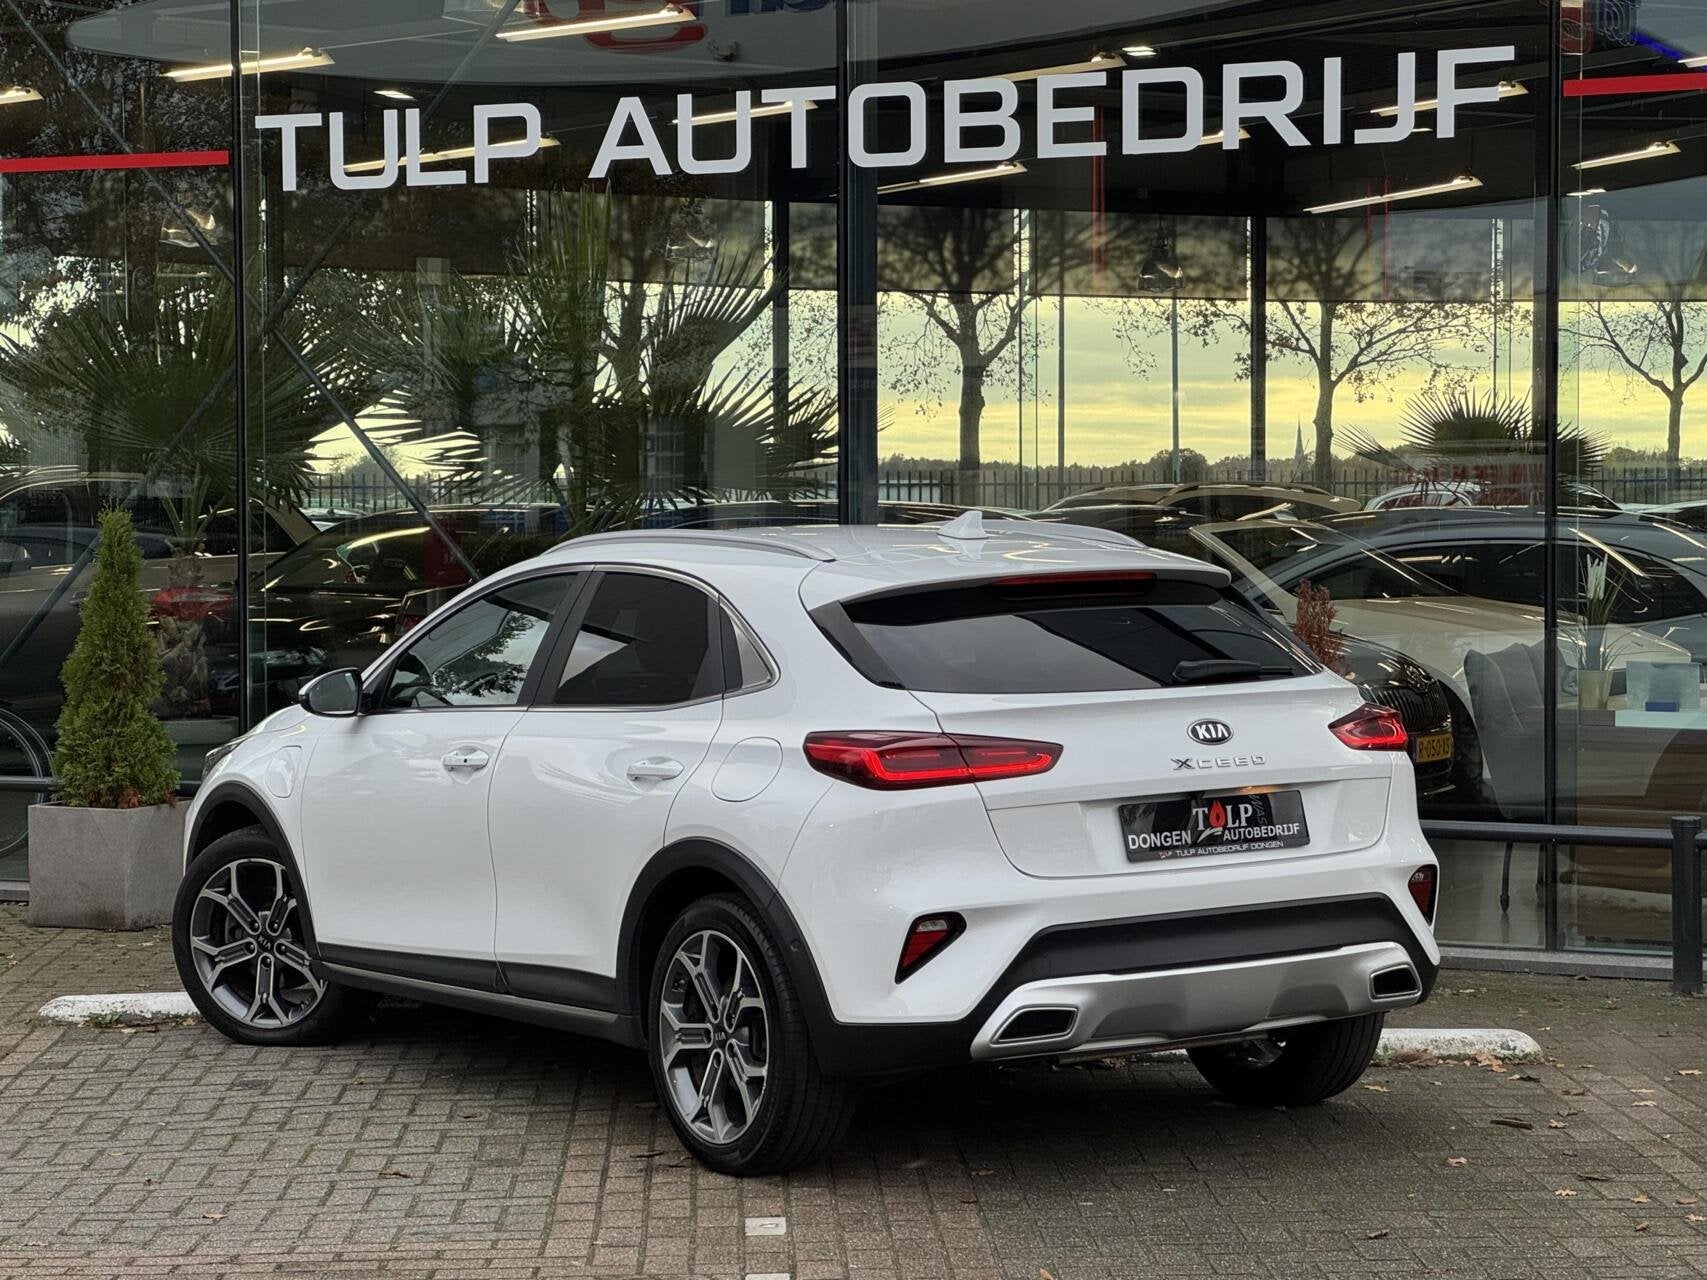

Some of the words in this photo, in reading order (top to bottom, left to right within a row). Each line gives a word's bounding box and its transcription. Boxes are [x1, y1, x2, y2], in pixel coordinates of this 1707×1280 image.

[255, 102, 541, 192] TULP
[589, 45, 1515, 180] AUTOBEDRIJF
[1194, 723, 1229, 740] KIA
[1170, 754, 1266, 771] XCEED
[1128, 830, 1191, 850] DONGEN
[1223, 822, 1300, 842] AUTOBEDRIJF
[1176, 847, 1196, 857] TULP
[1198, 845, 1249, 854] AUTOBEDRIJF
[1251, 840, 1284, 849] DONGEN
